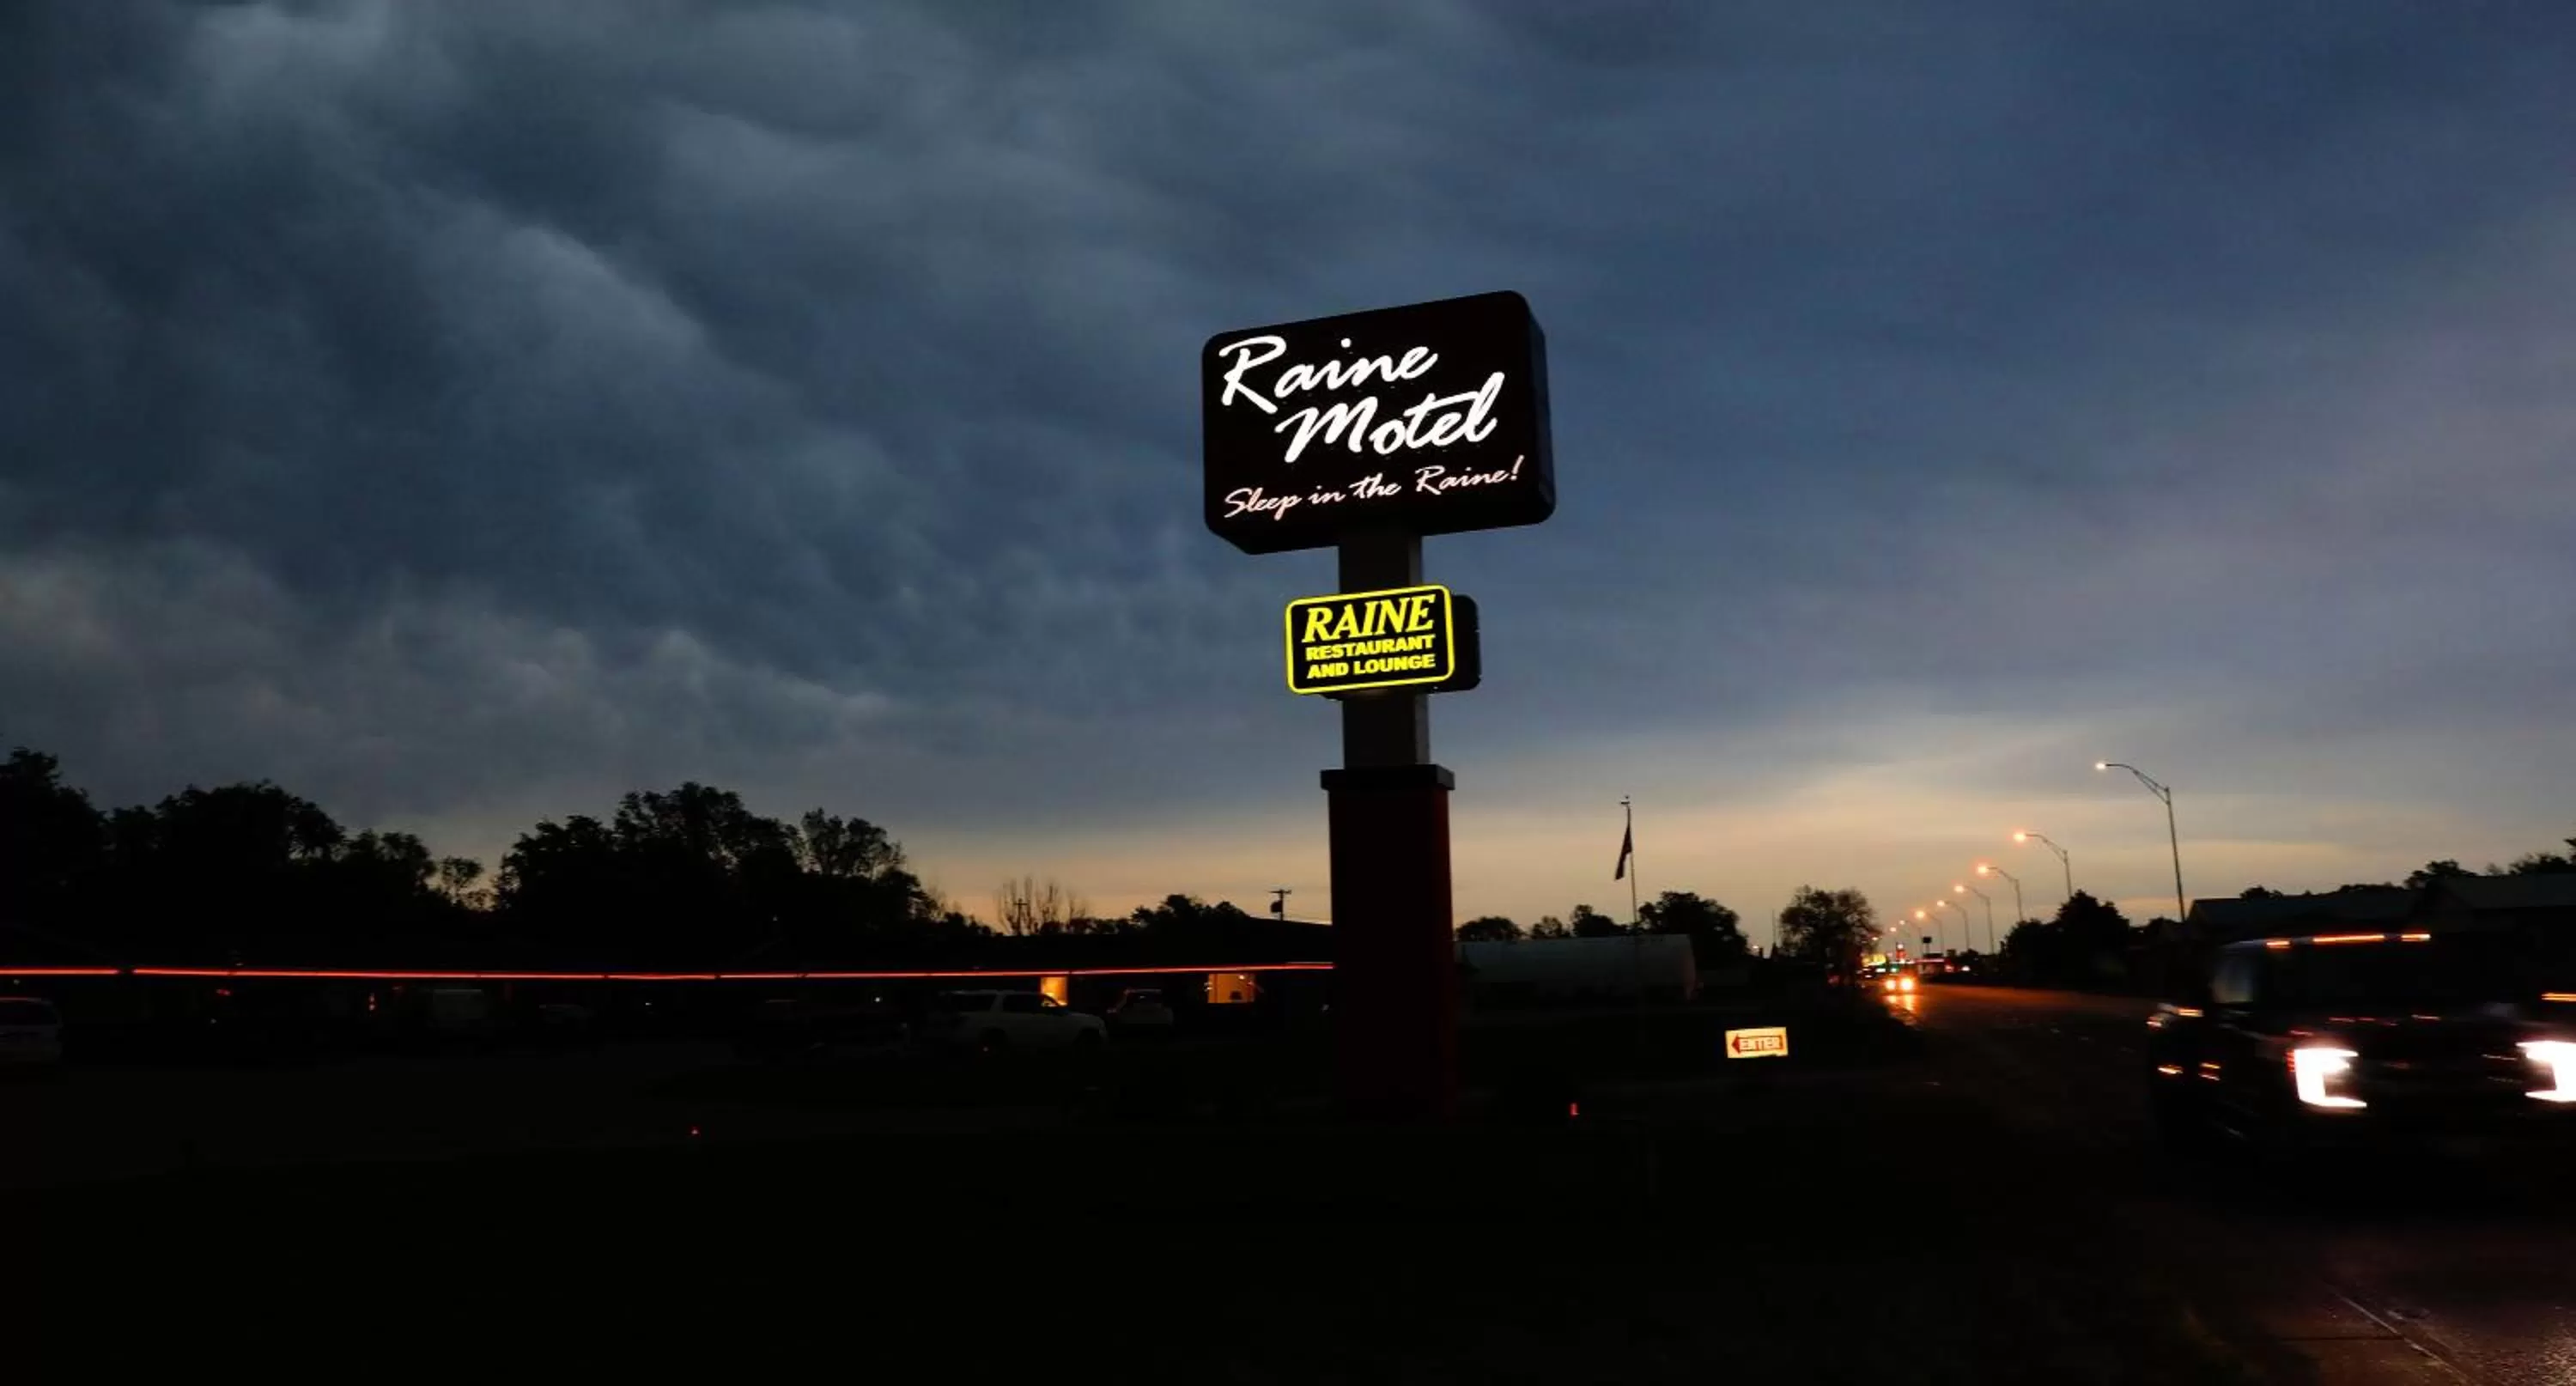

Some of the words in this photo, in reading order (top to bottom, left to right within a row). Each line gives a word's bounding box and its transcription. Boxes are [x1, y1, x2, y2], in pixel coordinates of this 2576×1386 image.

[1218, 335, 1438, 414] Raine
[1275, 372, 1505, 464] Motel
[1224, 487, 1303, 521] Sleep
[1308, 484, 1346, 505] in
[1348, 472, 1402, 499] the
[1414, 454, 1525, 495] Raine!
[1301, 593, 1437, 643] RAINE
[1305, 634, 1436, 661] RESTAURANT
[1306, 662, 1350, 679] AND
[1353, 653, 1437, 675] LOUNGE
[1740, 1036, 1779, 1050] ENTER
